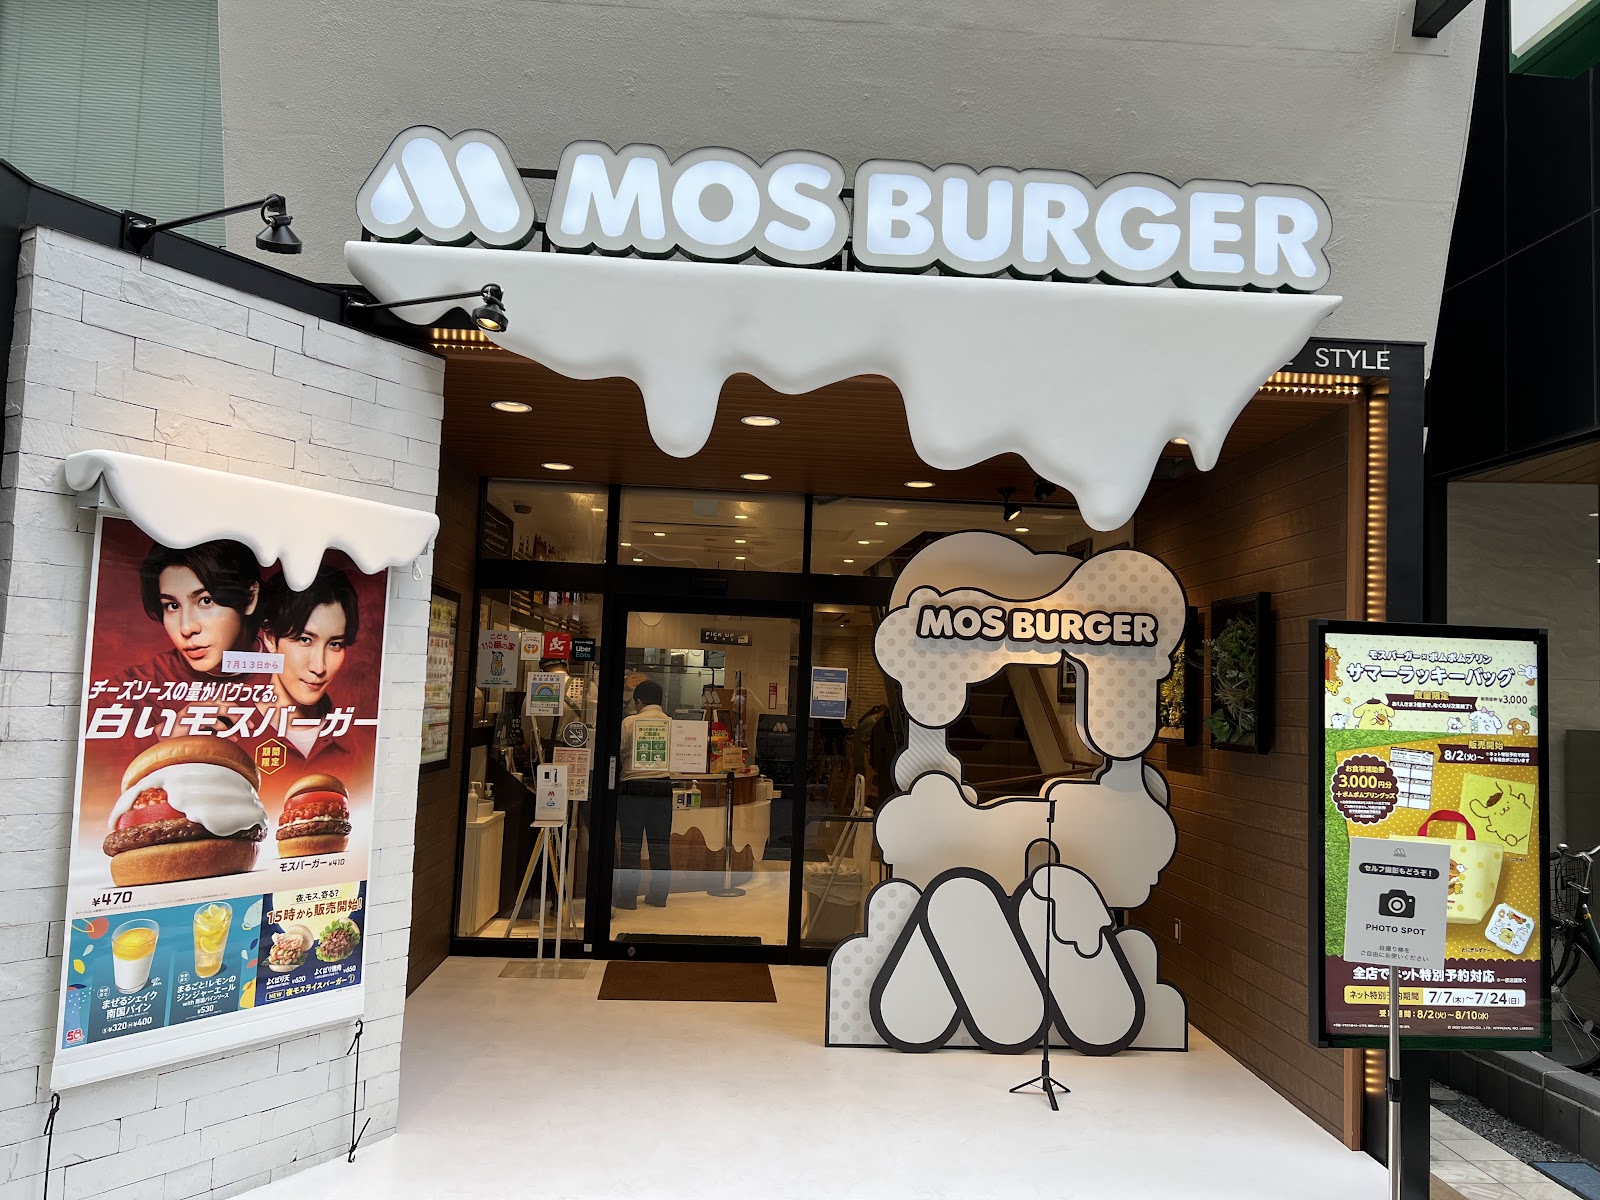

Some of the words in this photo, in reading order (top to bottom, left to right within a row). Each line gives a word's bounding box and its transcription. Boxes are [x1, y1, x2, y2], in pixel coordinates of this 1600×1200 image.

[560, 153, 836, 252] MOS
[866, 173, 1318, 278] BURGER
[1315, 347, 1391, 370] STYLE
[920, 608, 1005, 637] MOS
[1012, 611, 1156, 643] BURGER
[481, 640, 517, 651] 110番の家
[1346, 663, 1516, 688] サマーラッキーバッグ
[88, 679, 278, 703] チーズソースの量がバグってる。
[1413, 690, 1450, 701] 数量限定
[1499, 695, 1528, 705] ¥3,000
[85, 703, 379, 739] 白いモスバーガー
[262, 747, 281, 756] 期間
[1468, 740, 1504, 750] 販売開始
[261, 757, 280, 767] 限定
[1345, 765, 1385, 774] お食事補助券
[279, 859, 327, 872] モスバーガー
[328, 858, 345, 867] ¥410
[91, 891, 132, 907] ¥470
[267, 898, 363, 924] 15時から販売開始!
[1365, 923, 1398, 933] PHOTO
[1401, 927, 1426, 936] SPOT
[1360, 950, 1429, 962] ご自由にお使いください
[1379, 945, 1410, 953] 自撮り棒を
[1352, 966, 1495, 983] 全店でット特別予約対応
[176, 983, 236, 1002] ジンジャーエール
[268, 991, 283, 1000] NEW
[285, 976, 348, 997] 夜モスライスバーガー
[102, 990, 158, 1010] まぜるシェイク
[182, 999, 195, 1007] with
[106, 1003, 151, 1019] 南国パイン
[197, 1004, 214, 1015] ¥530
[108, 1021, 127, 1033] ¥320
[133, 1016, 153, 1027] ¥400
